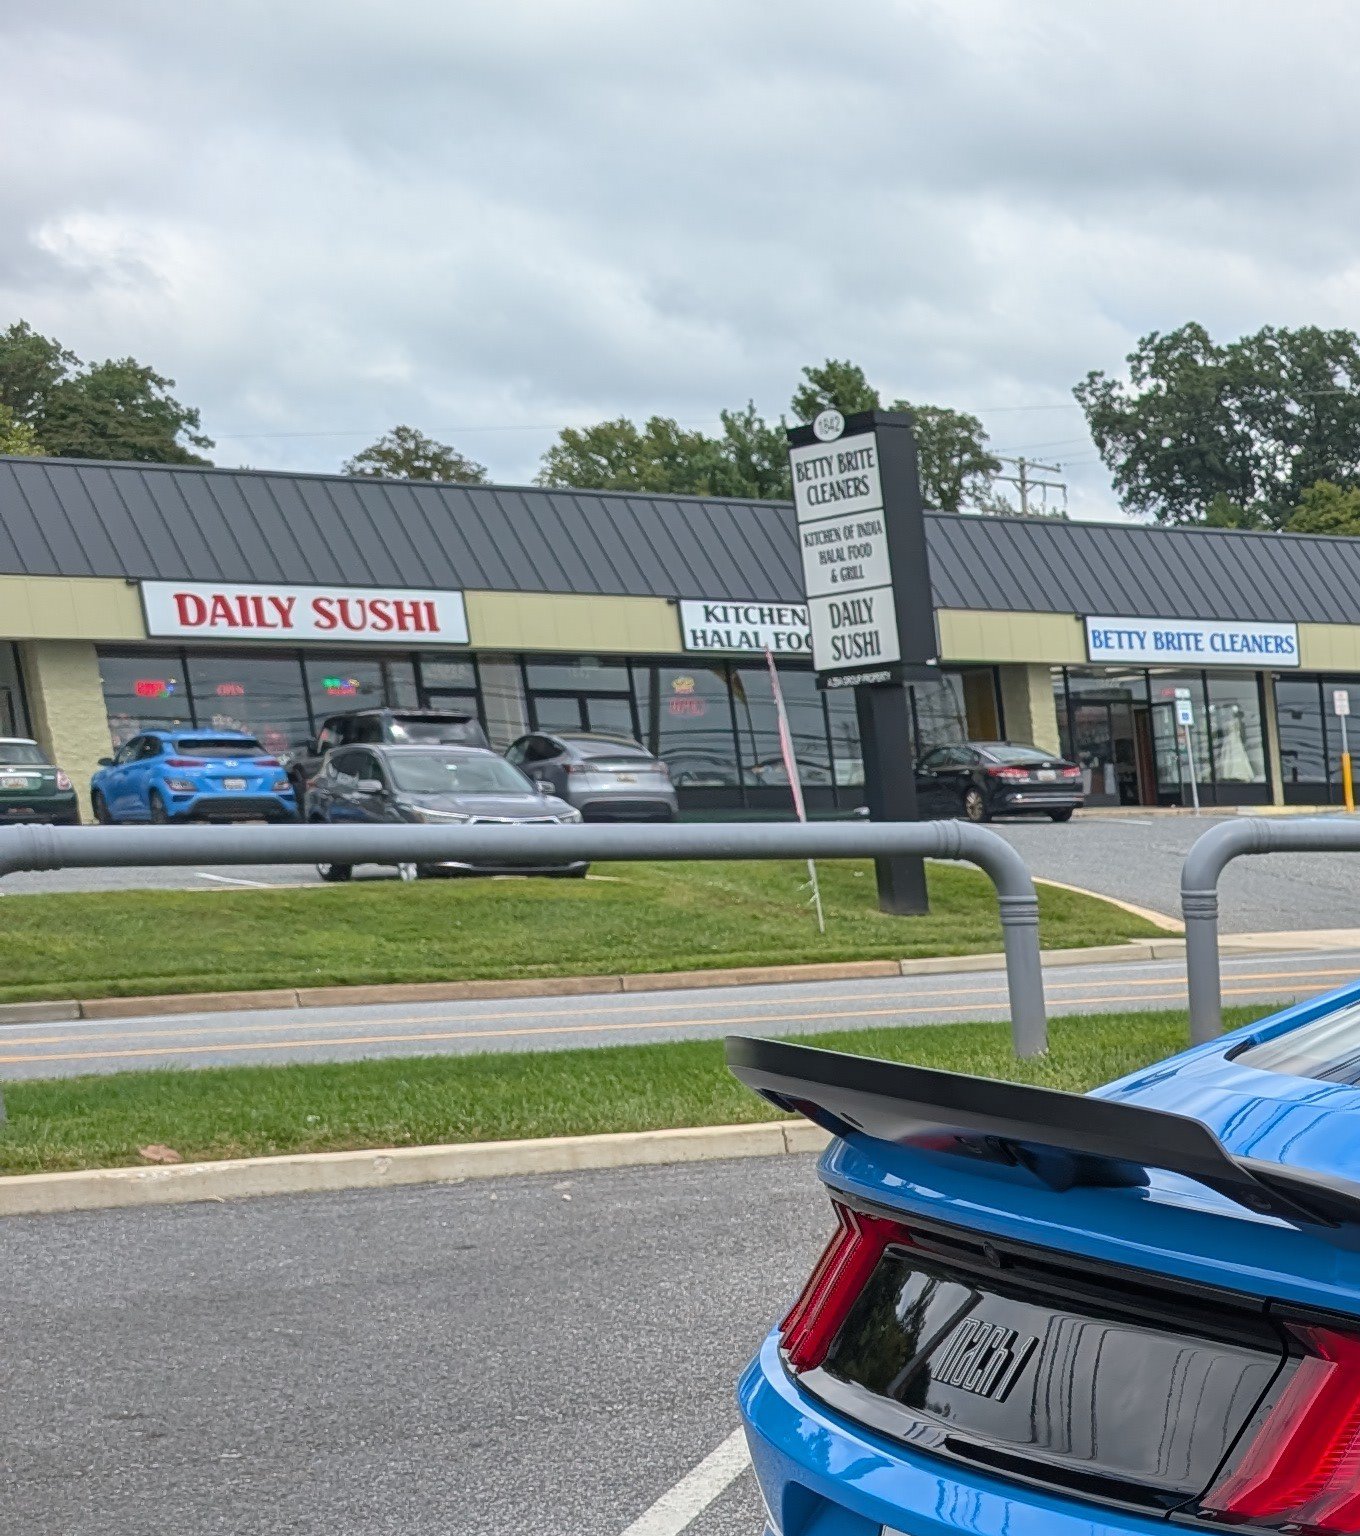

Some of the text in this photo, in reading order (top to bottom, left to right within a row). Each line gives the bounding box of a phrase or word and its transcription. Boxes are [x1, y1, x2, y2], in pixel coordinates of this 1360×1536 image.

[795, 446, 875, 483] BETTY BRITE
[807, 474, 870, 506] CLEANERS
[173, 593, 441, 633] DAILY SUSHI
[702, 604, 808, 626] KITCHEN
[829, 597, 874, 629] DAILY
[690, 628, 766, 649] HALAL
[831, 630, 881, 661] SUSHI
[1091, 629, 1295, 654] BETTY BRITE CLEANERS
